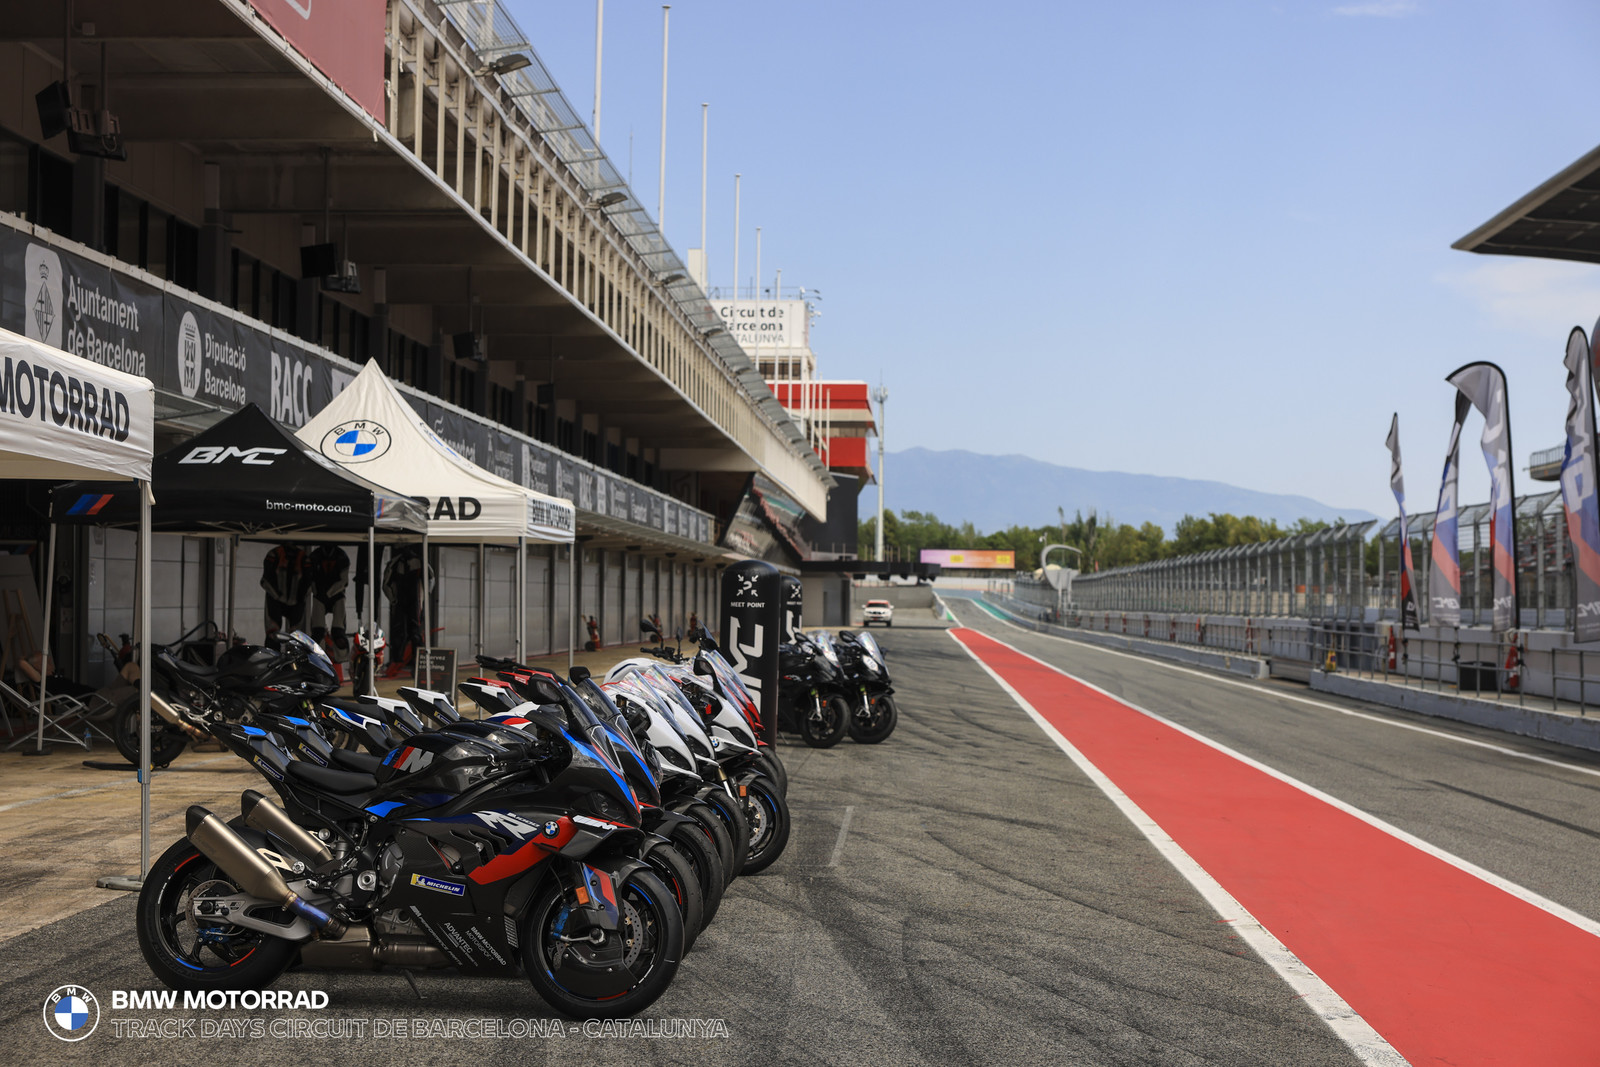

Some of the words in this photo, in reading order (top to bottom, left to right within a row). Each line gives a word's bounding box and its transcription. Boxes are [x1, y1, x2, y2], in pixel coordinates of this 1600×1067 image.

[67, 275, 139, 333] Ajuntament
[720, 305, 765, 318] Cicut
[67, 326, 84, 358] de
[86, 335, 146, 377] Barcelona
[204, 332, 247, 373] Diputació
[0, 356, 130, 443] MOTORRAD
[204, 368, 246, 405] Barcelona
[270, 351, 313, 427] RACC
[333, 422, 384, 436] BMW
[178, 446, 287, 465] BMC
[266, 499, 352, 514] bmc-moto.com
[426, 881, 461, 893] MICHELIN
[444, 922, 473, 954] ADVANTEC
[470, 926, 484, 940] BMW
[482, 938, 507, 966] MOTORRAD
